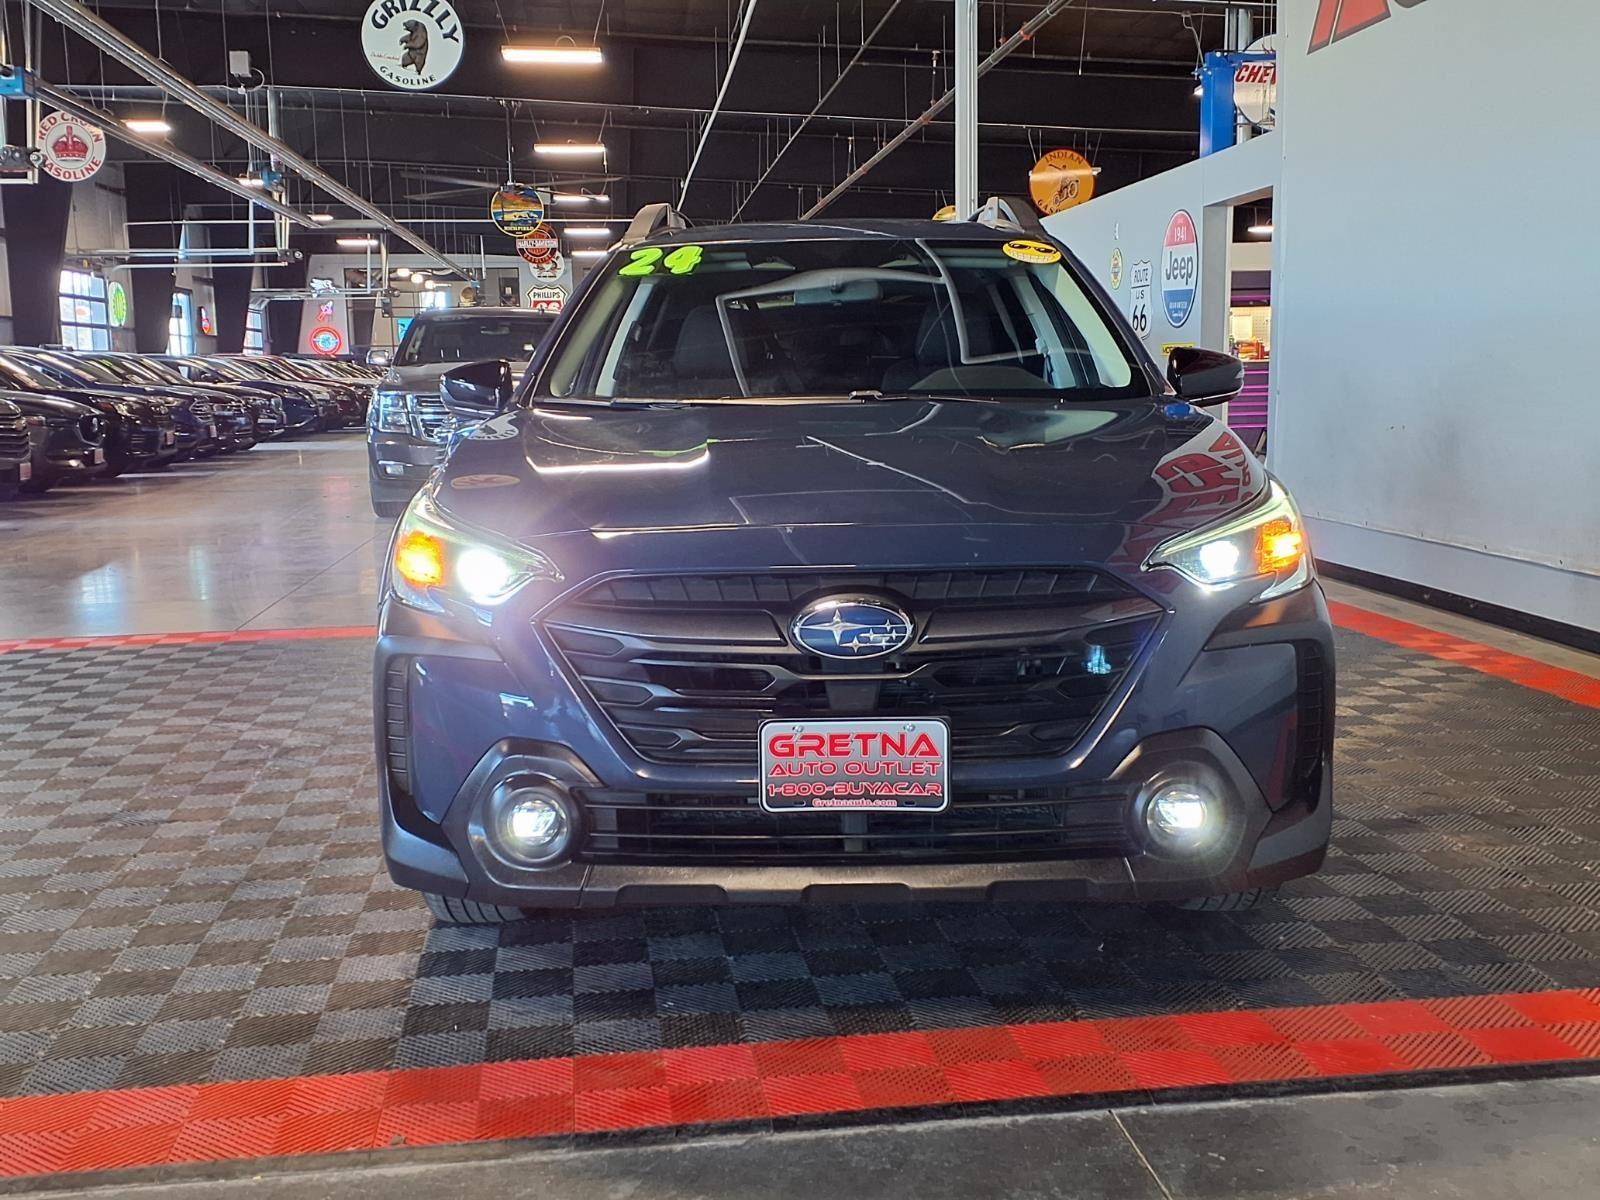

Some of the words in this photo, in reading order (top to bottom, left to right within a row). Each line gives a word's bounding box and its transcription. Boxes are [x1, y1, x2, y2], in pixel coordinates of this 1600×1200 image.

[371, 0, 459, 43] GRIZZLY
[380, 66, 437, 86] GASOLINE
[38, 115, 57, 141] RED
[1045, 151, 1084, 165] INDIAN
[1174, 226, 1187, 242] 1941
[619, 246, 703, 276] 24
[1165, 251, 1194, 286] Jeep
[1133, 267, 1149, 283] ROUTE
[533, 291, 561, 299] PHILLIPS
[1132, 305, 1147, 332] 66
[768, 732, 940, 758] GRETNA
[768, 761, 837, 777] AUTO
[843, 761, 943, 776] OUTLET
[767, 782, 943, 797] 1-800-BUYACAR
[811, 797, 898, 808] Gretnaauto.com
